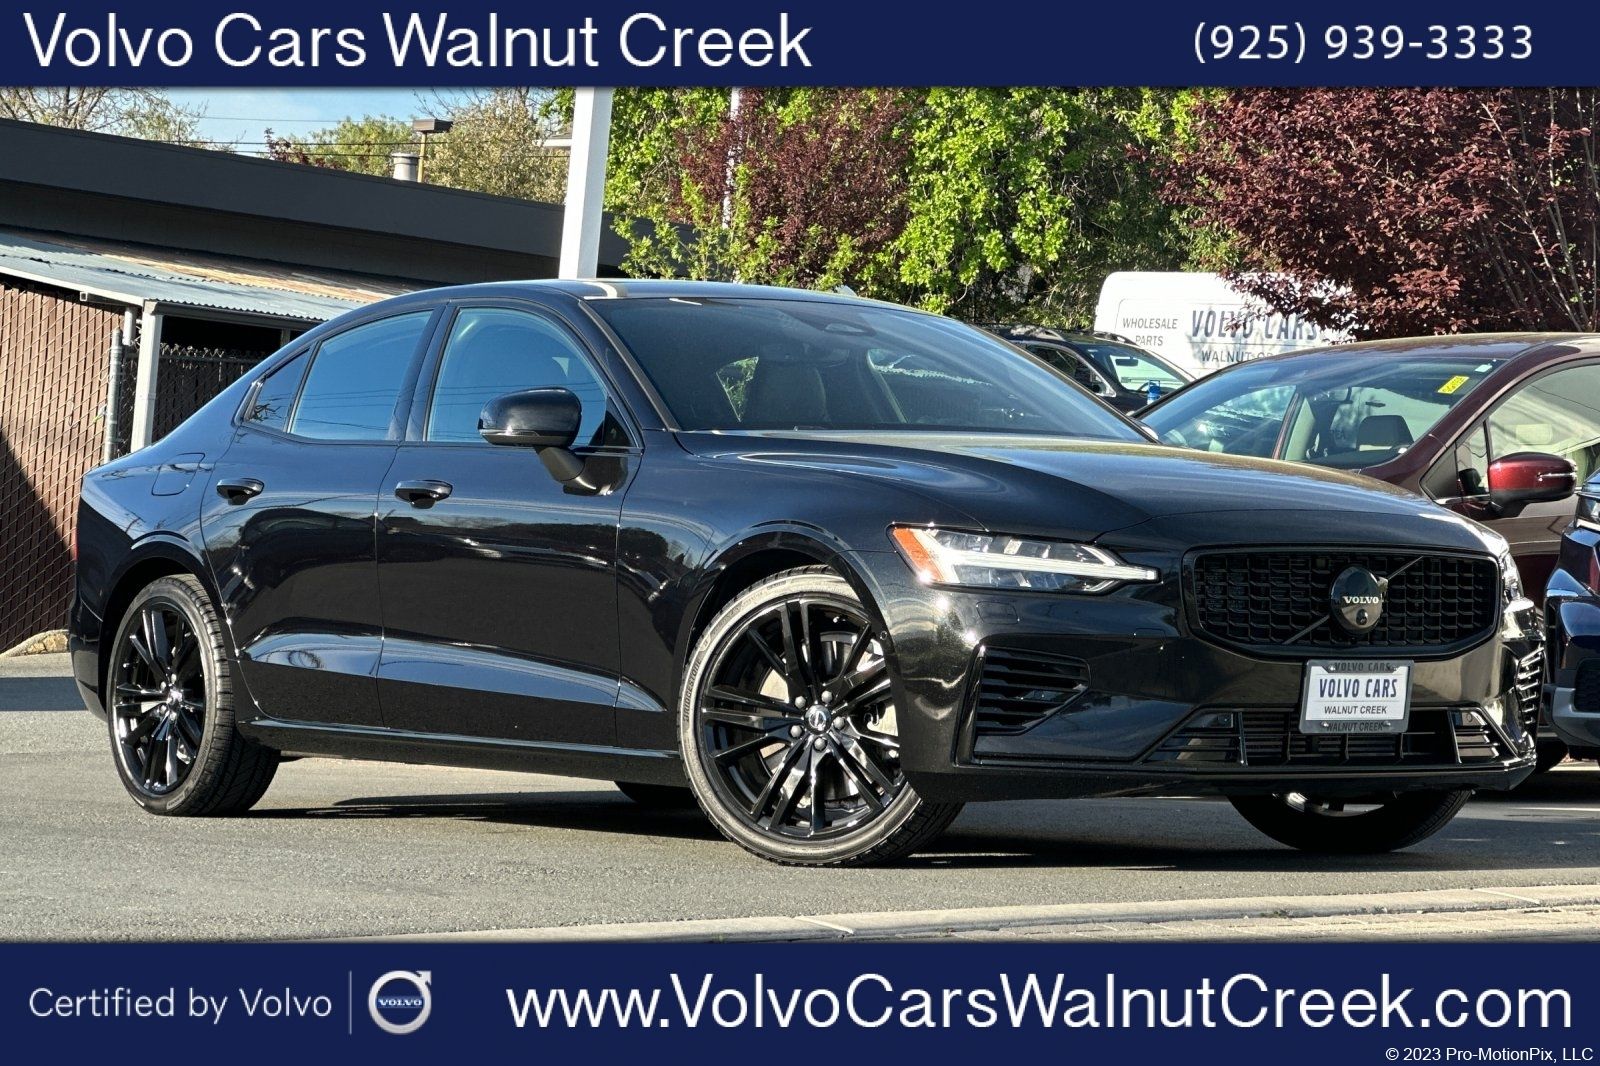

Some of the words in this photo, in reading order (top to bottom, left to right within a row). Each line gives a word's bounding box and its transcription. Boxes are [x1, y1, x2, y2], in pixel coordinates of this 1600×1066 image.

[1122, 318, 1178, 329] WHOLESALE
[1192, 310, 1254, 339] VOLVO
[1135, 335, 1164, 346] PARTS
[1201, 350, 1252, 363] WALNUT
[1343, 595, 1380, 604] VOLVO
[1334, 662, 1364, 671] VOLVO
[1368, 662, 1391, 672] CARS
[1319, 678, 1360, 697] VOLVO
[1365, 678, 1398, 698] CARS
[1324, 705, 1358, 714] WALNUT
[1360, 705, 1387, 714] CREEK
[1327, 721, 1358, 731] WALNUT
[1359, 721, 1384, 731] CREEK
